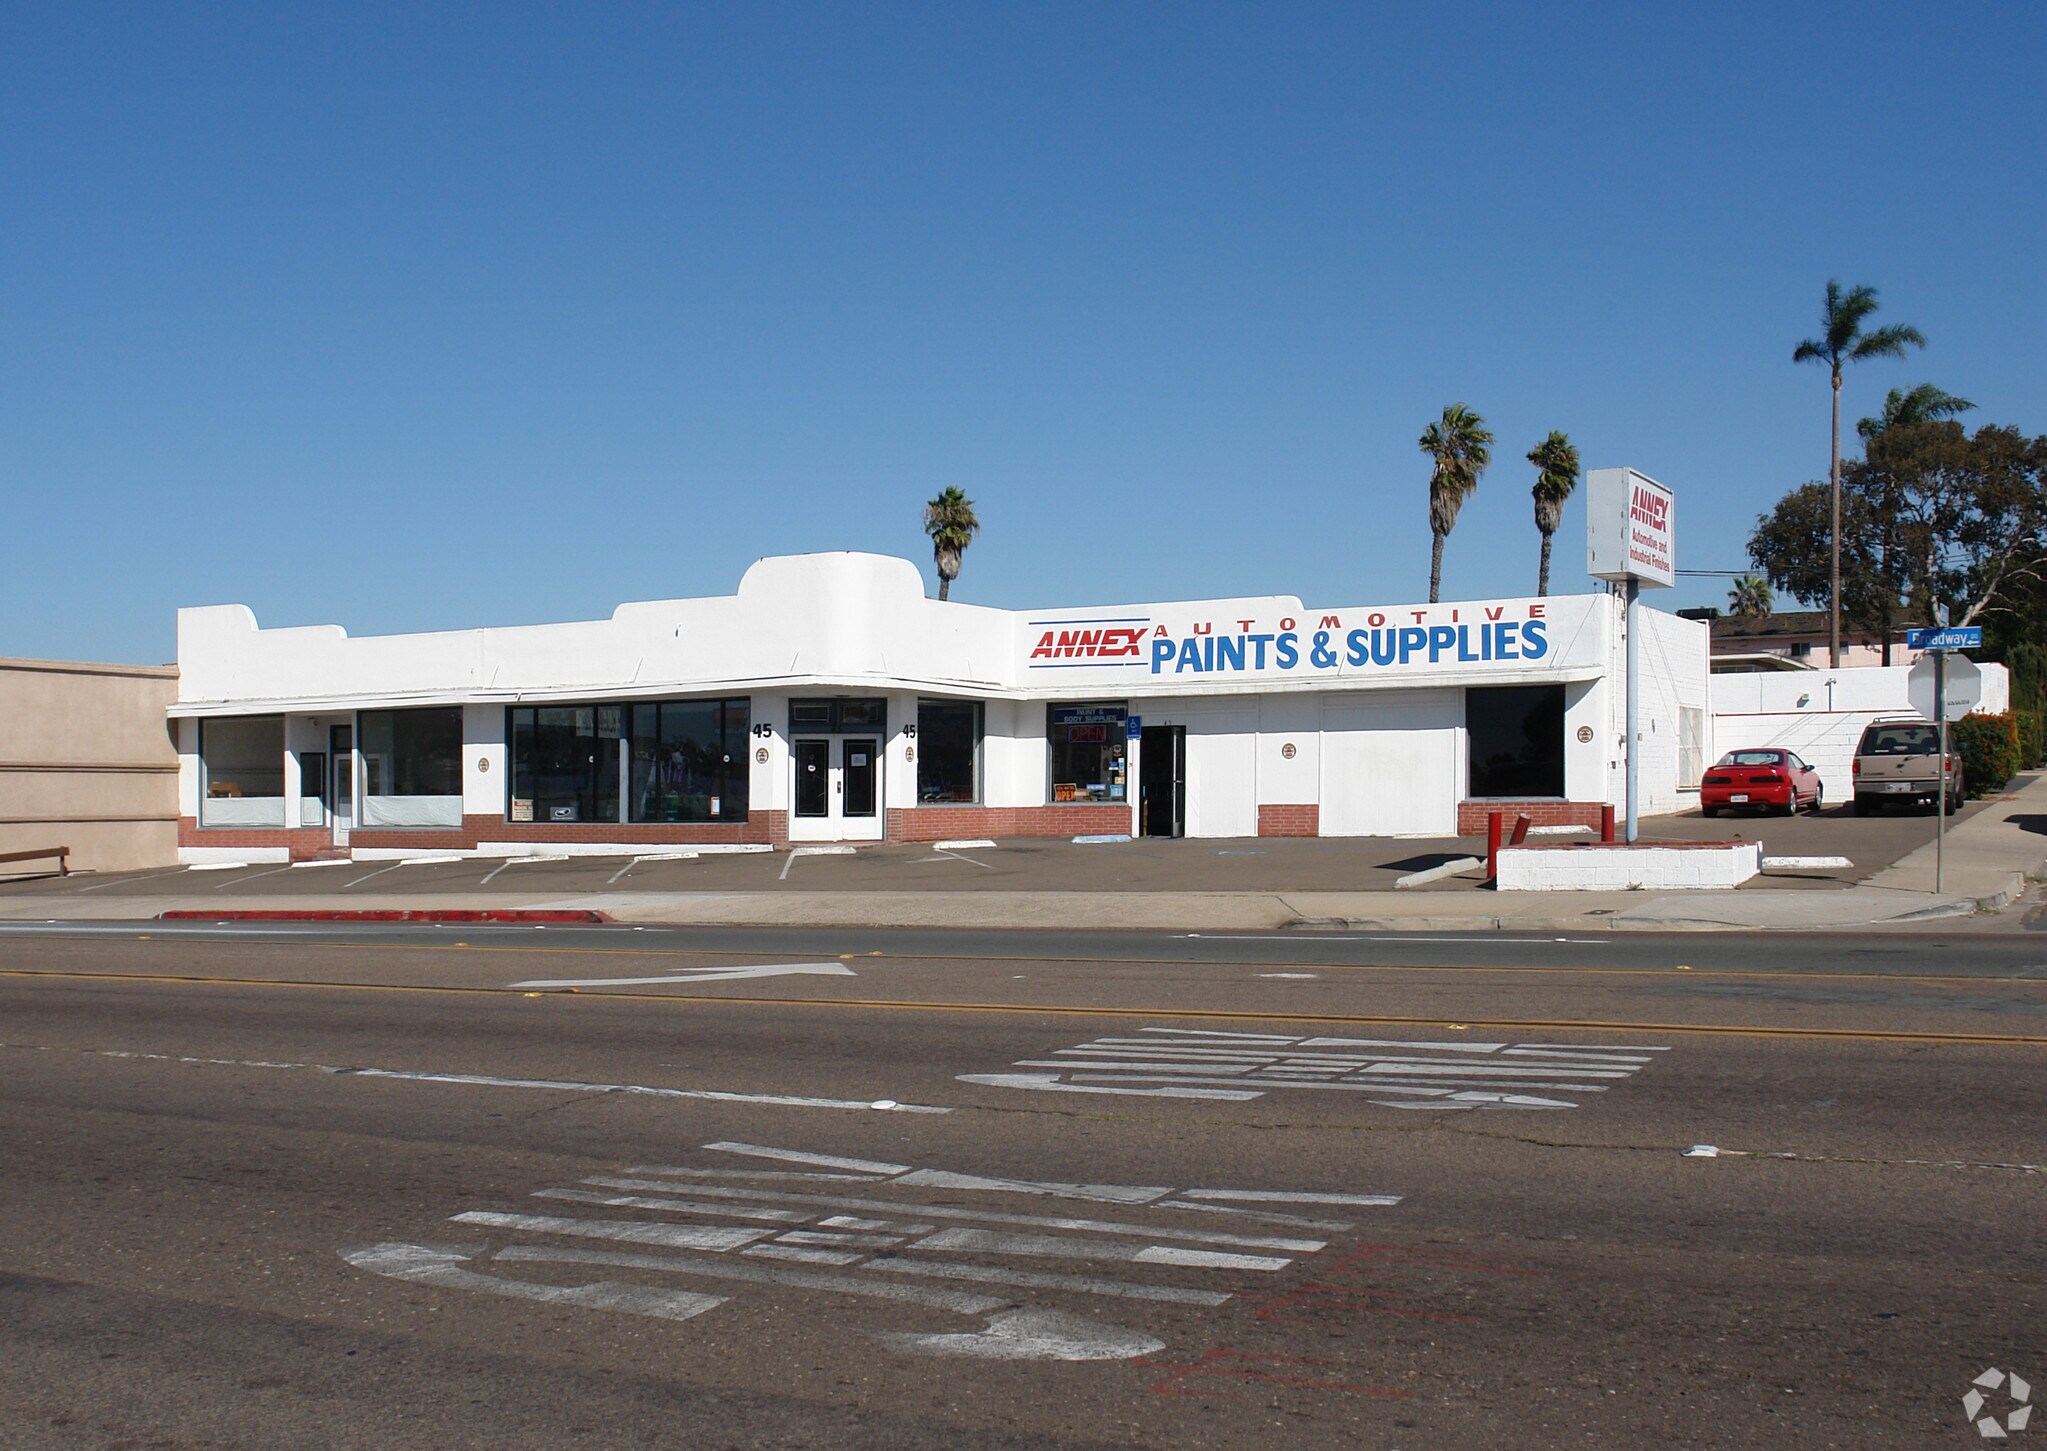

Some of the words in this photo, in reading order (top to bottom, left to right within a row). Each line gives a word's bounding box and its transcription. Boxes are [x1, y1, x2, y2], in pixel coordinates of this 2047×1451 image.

[1630, 486, 1669, 533] ANNEX
[1632, 528, 1658, 550] Automotive
[1659, 541, 1667, 554] and
[1630, 545, 1652, 566] Industrial
[1652, 555, 1670, 573] Finishes
[1154, 604, 1547, 639] AUTOMOTIVE
[1030, 628, 1149, 659] ANNEX
[1151, 631, 1299, 675] PAINTS
[1310, 629, 1338, 669] &
[1346, 619, 1549, 667] SUPPLIES
[1912, 632, 1967, 647] Broadway
[753, 723, 772, 738] 45
[903, 724, 916, 738] 45
[1070, 726, 1105, 743] OPEN
